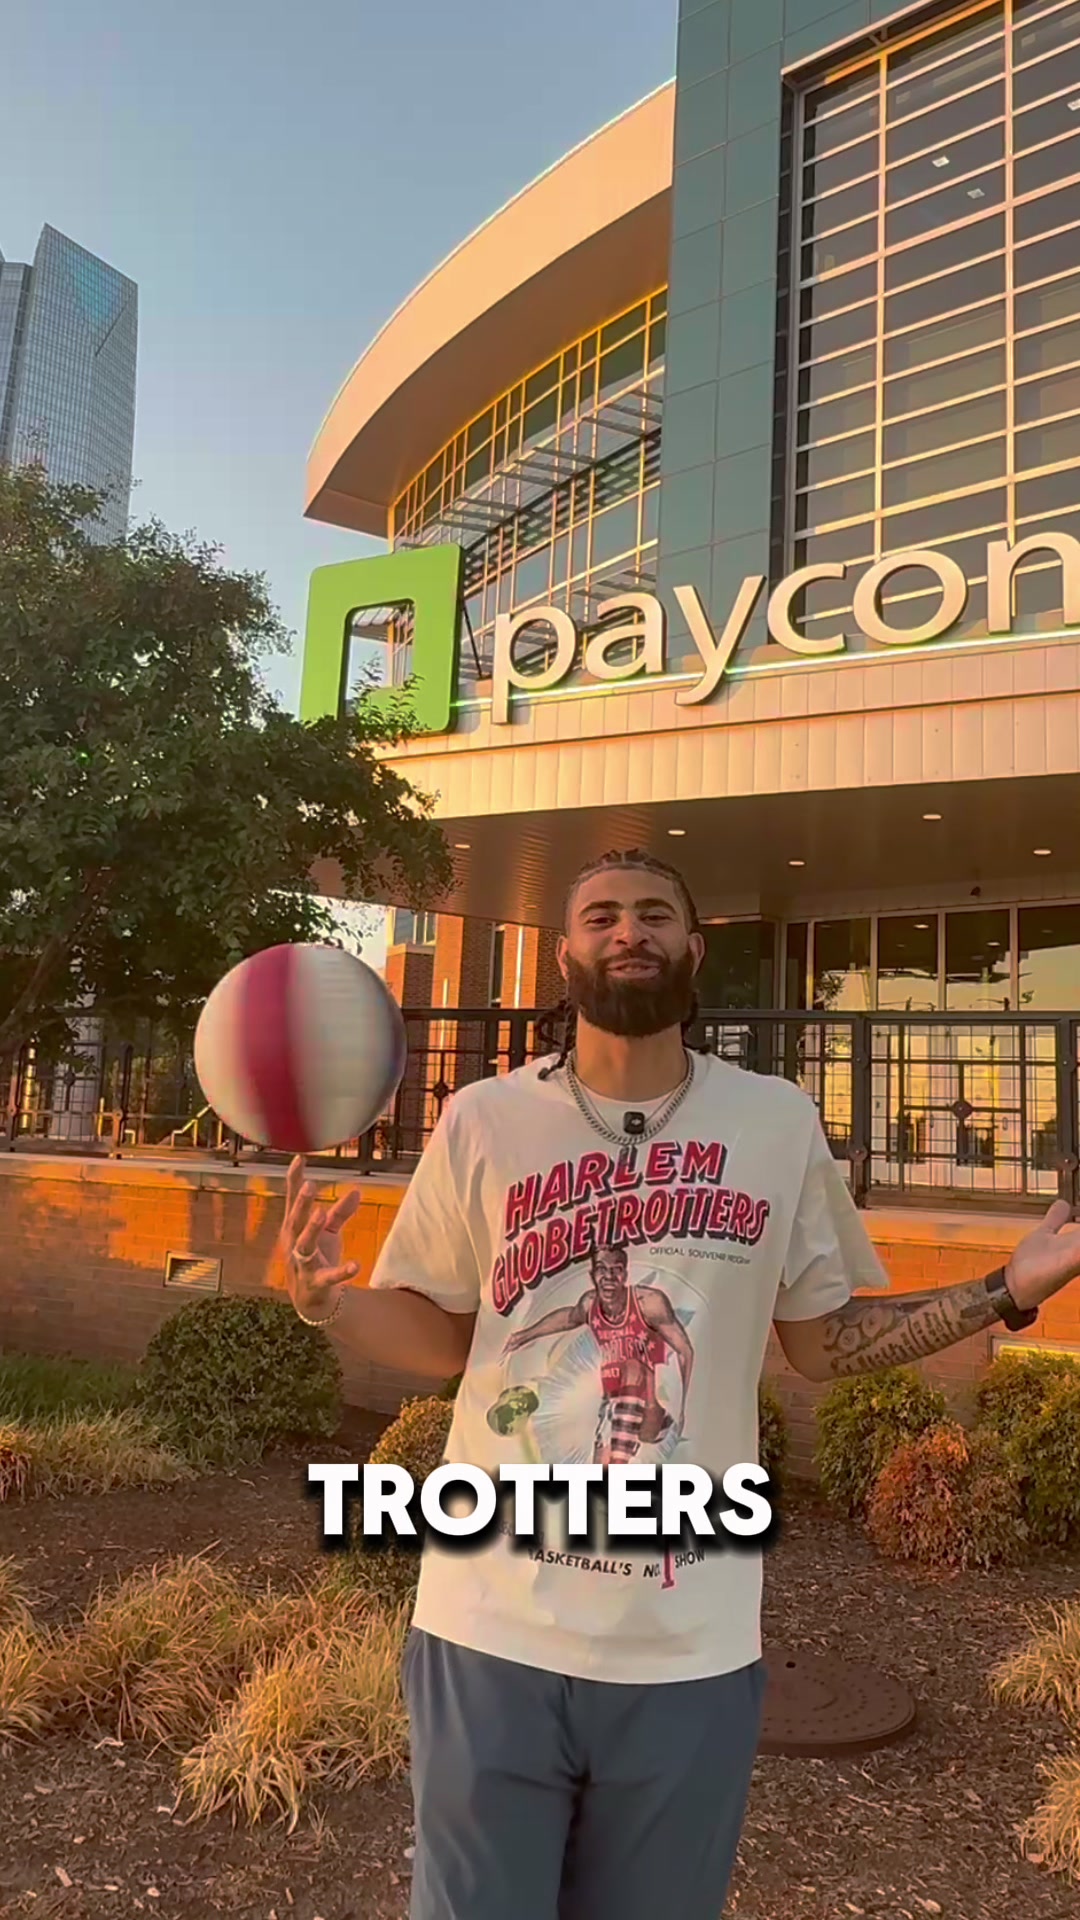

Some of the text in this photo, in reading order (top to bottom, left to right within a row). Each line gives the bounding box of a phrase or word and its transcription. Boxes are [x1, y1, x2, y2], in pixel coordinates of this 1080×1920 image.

[504, 1141, 727, 1240] HARLEM
[491, 1187, 769, 1317] GLOBETROTTERS
[649, 1247, 685, 1256] OFFICIAL
[674, 1549, 705, 1568] SHOW
